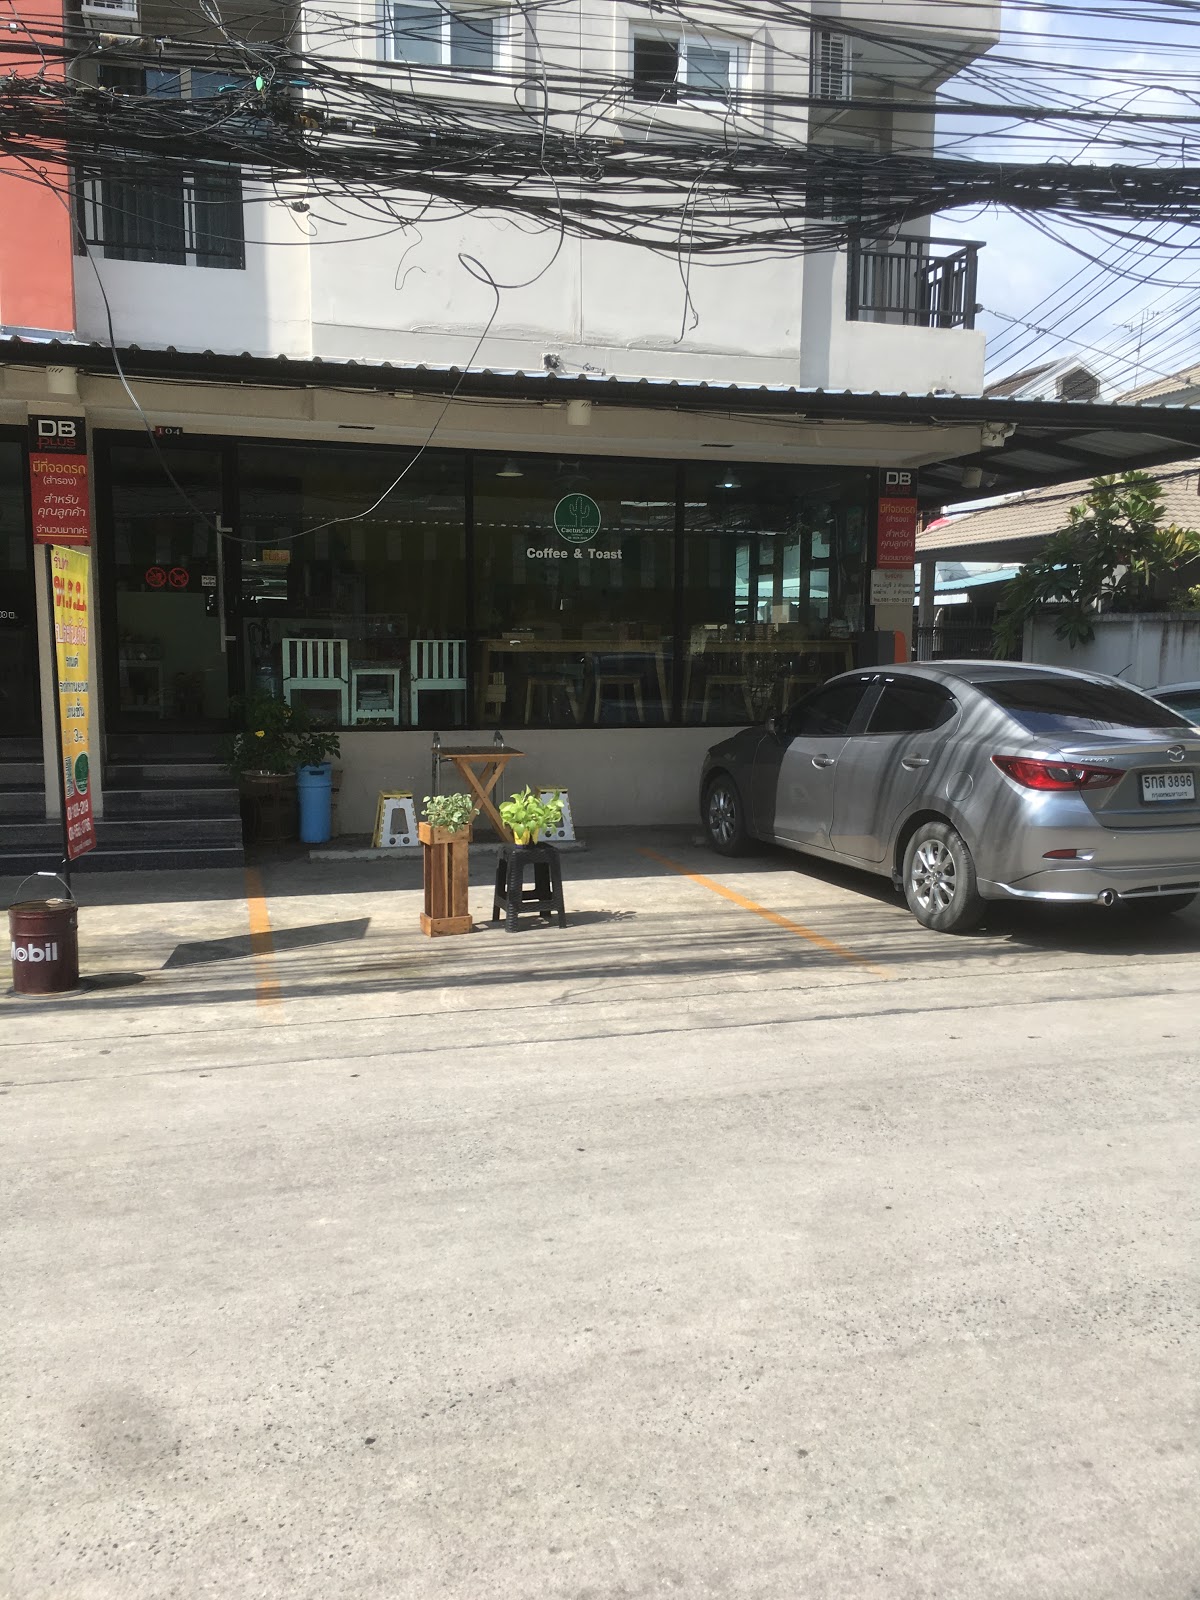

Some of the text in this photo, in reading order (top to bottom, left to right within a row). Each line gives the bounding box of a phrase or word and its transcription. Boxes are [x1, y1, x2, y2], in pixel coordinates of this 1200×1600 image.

[38, 419, 77, 437] DB
[158, 427, 180, 435] 104
[32, 459, 86, 475] มีที่จอดรถ
[43, 476, 77, 487] (สำรอง)
[886, 471, 912, 485] DB
[44, 493, 79, 505] สำหรับ
[38, 506, 86, 519] คุณลูกค้า
[36, 524, 88, 534] จำนวนมากค่ะ
[526, 547, 622, 559] Coffee & Toast
[1144, 774, 1192, 789] 5กส 3896
